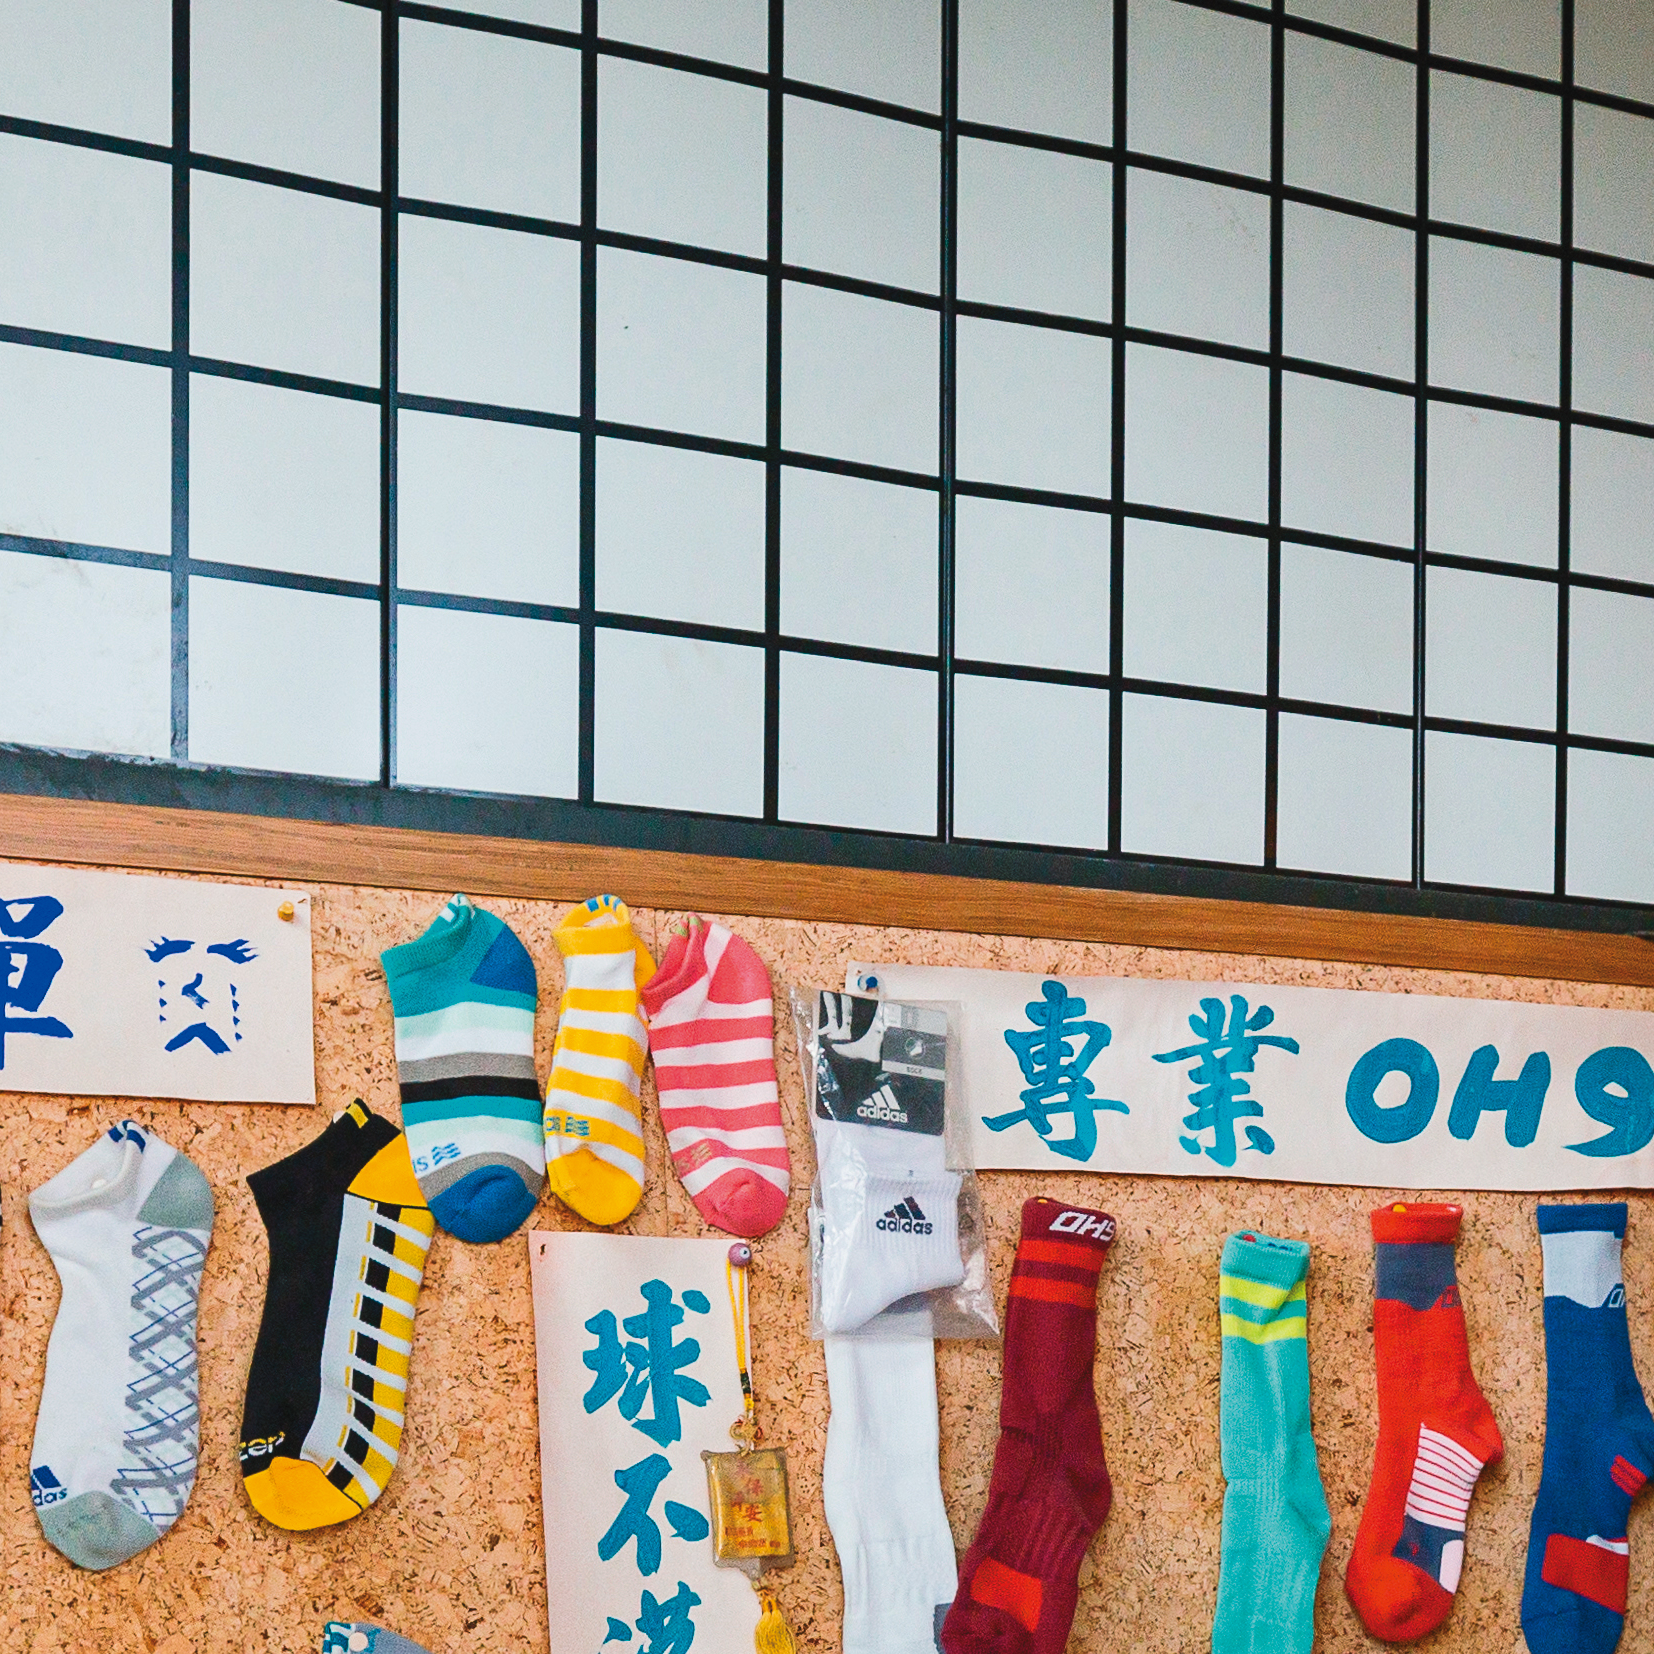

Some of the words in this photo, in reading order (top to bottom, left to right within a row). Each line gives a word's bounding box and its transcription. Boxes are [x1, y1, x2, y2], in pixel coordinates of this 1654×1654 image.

[981, 979, 1300, 1168] 專業
[856, 1106, 908, 1123] adidas
[876, 1217, 934, 1235] adidas
